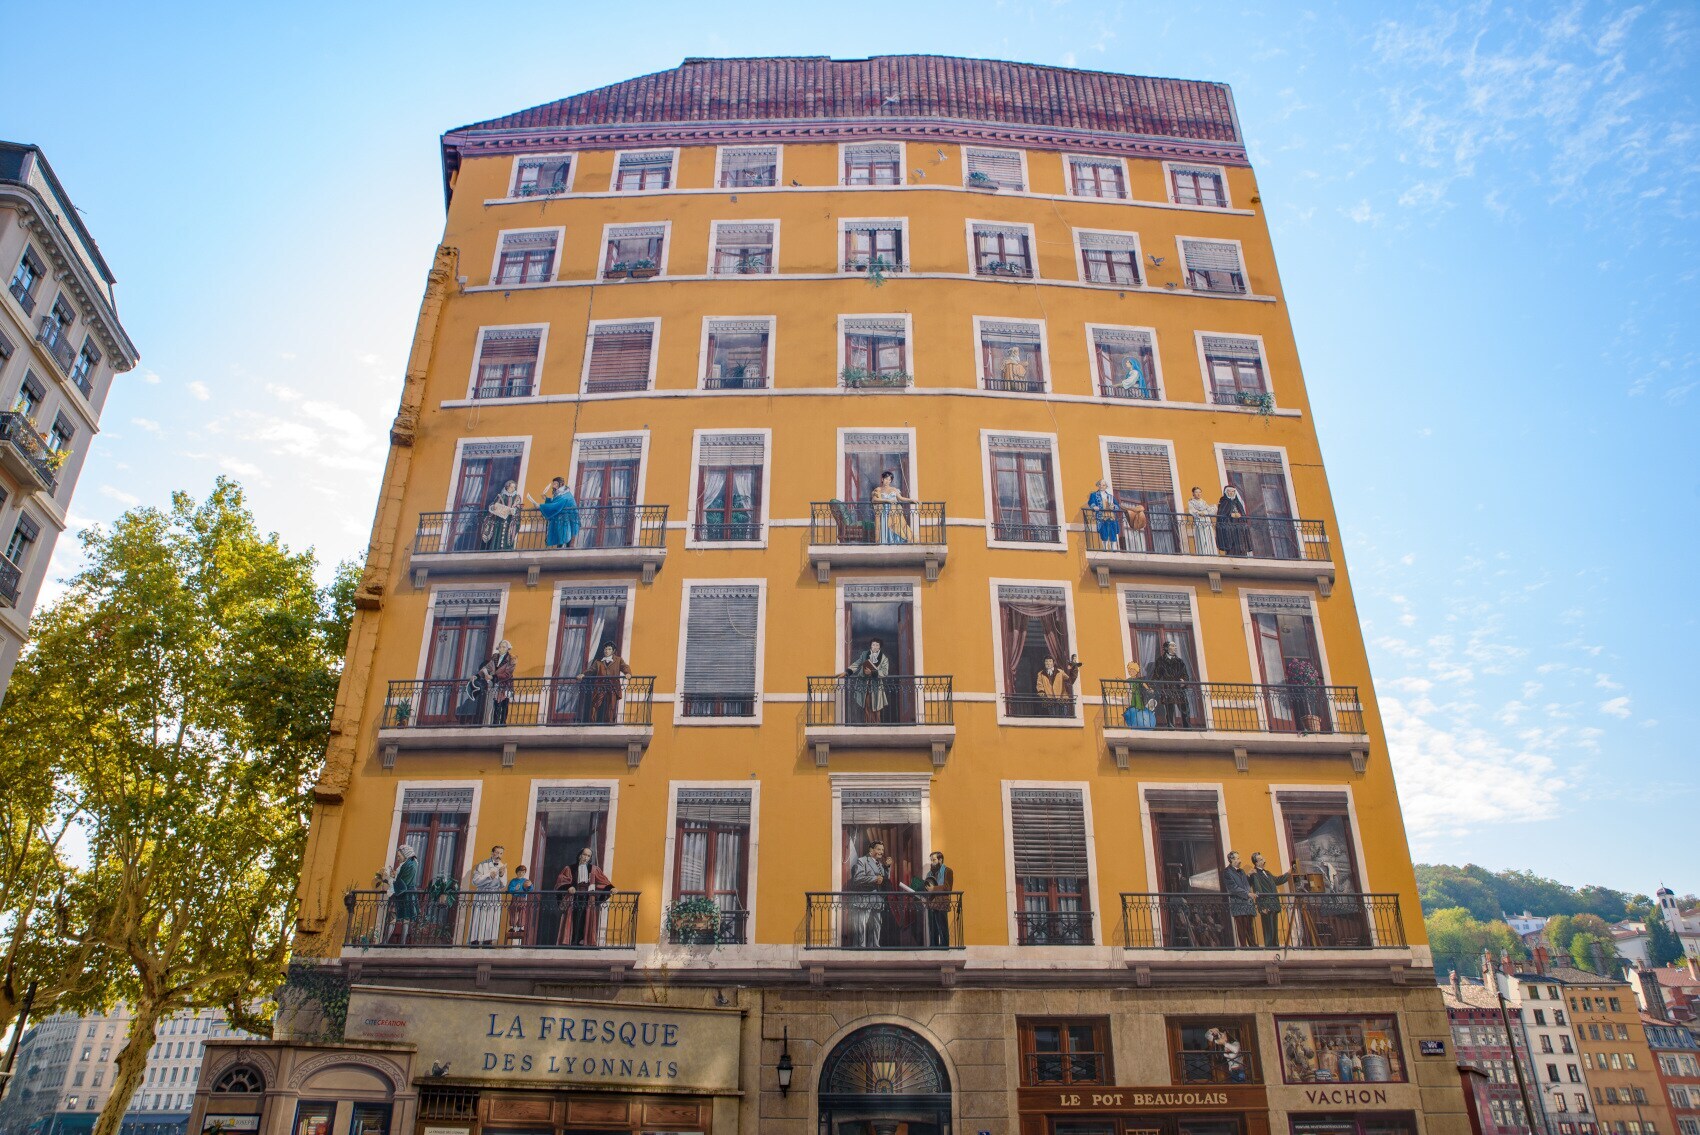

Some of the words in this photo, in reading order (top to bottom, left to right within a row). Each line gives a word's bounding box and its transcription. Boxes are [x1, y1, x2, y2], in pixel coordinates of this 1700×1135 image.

[486, 1013, 526, 1039] LA
[537, 1016, 679, 1048] FRESQUE
[482, 1052, 533, 1072] DES
[548, 1056, 678, 1078] LYONNAIS
[1060, 1094, 1081, 1106] LE
[1092, 1094, 1124, 1106] POT
[1133, 1092, 1228, 1106] BEAUJOLAIS
[1305, 1089, 1387, 1104] VACHON
